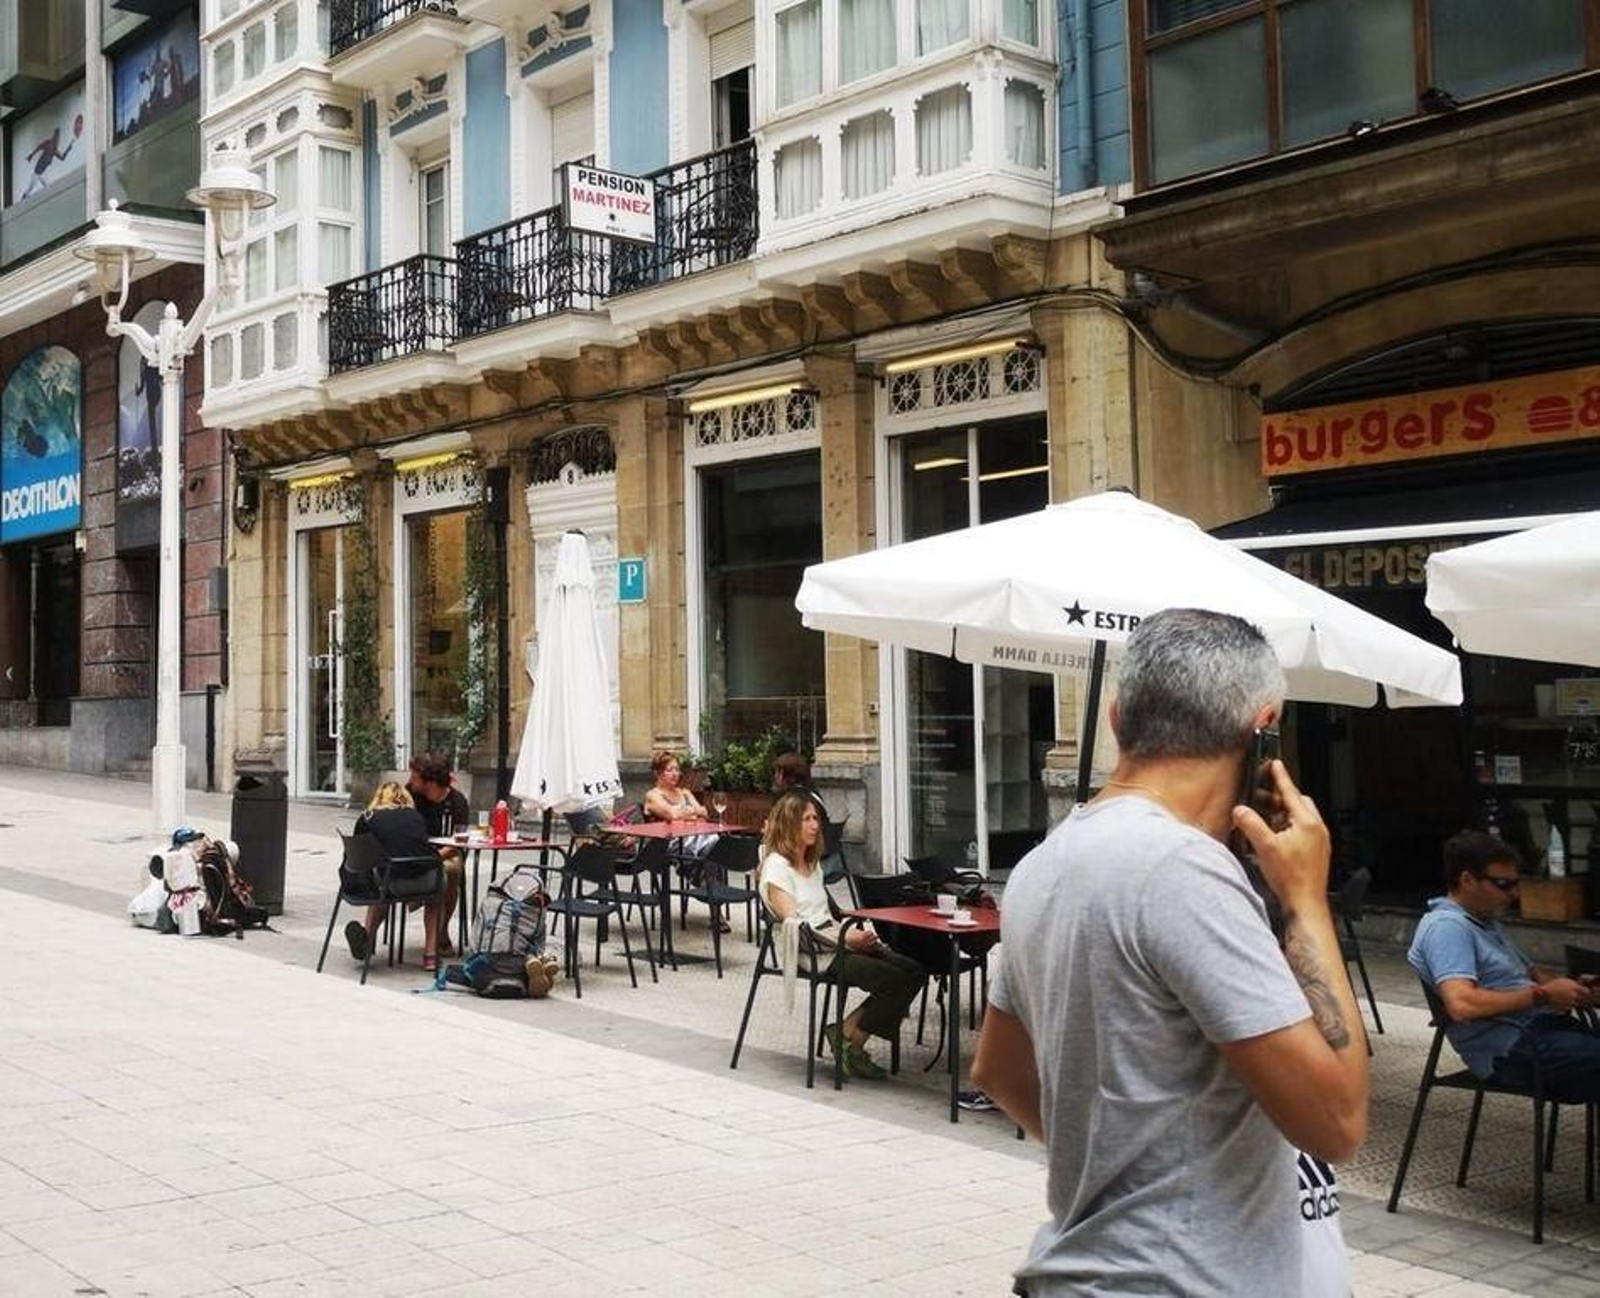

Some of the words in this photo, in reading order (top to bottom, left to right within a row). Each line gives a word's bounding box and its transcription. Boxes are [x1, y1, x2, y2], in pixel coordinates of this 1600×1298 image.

[578, 170, 645, 195] PENSION
[572, 187, 651, 215] MARTINEZ
[566, 469, 574, 485] 8
[2, 472, 81, 522] DECATHLON
[626, 563, 638, 586] P
[1324, 541, 1461, 587] DEPOS
